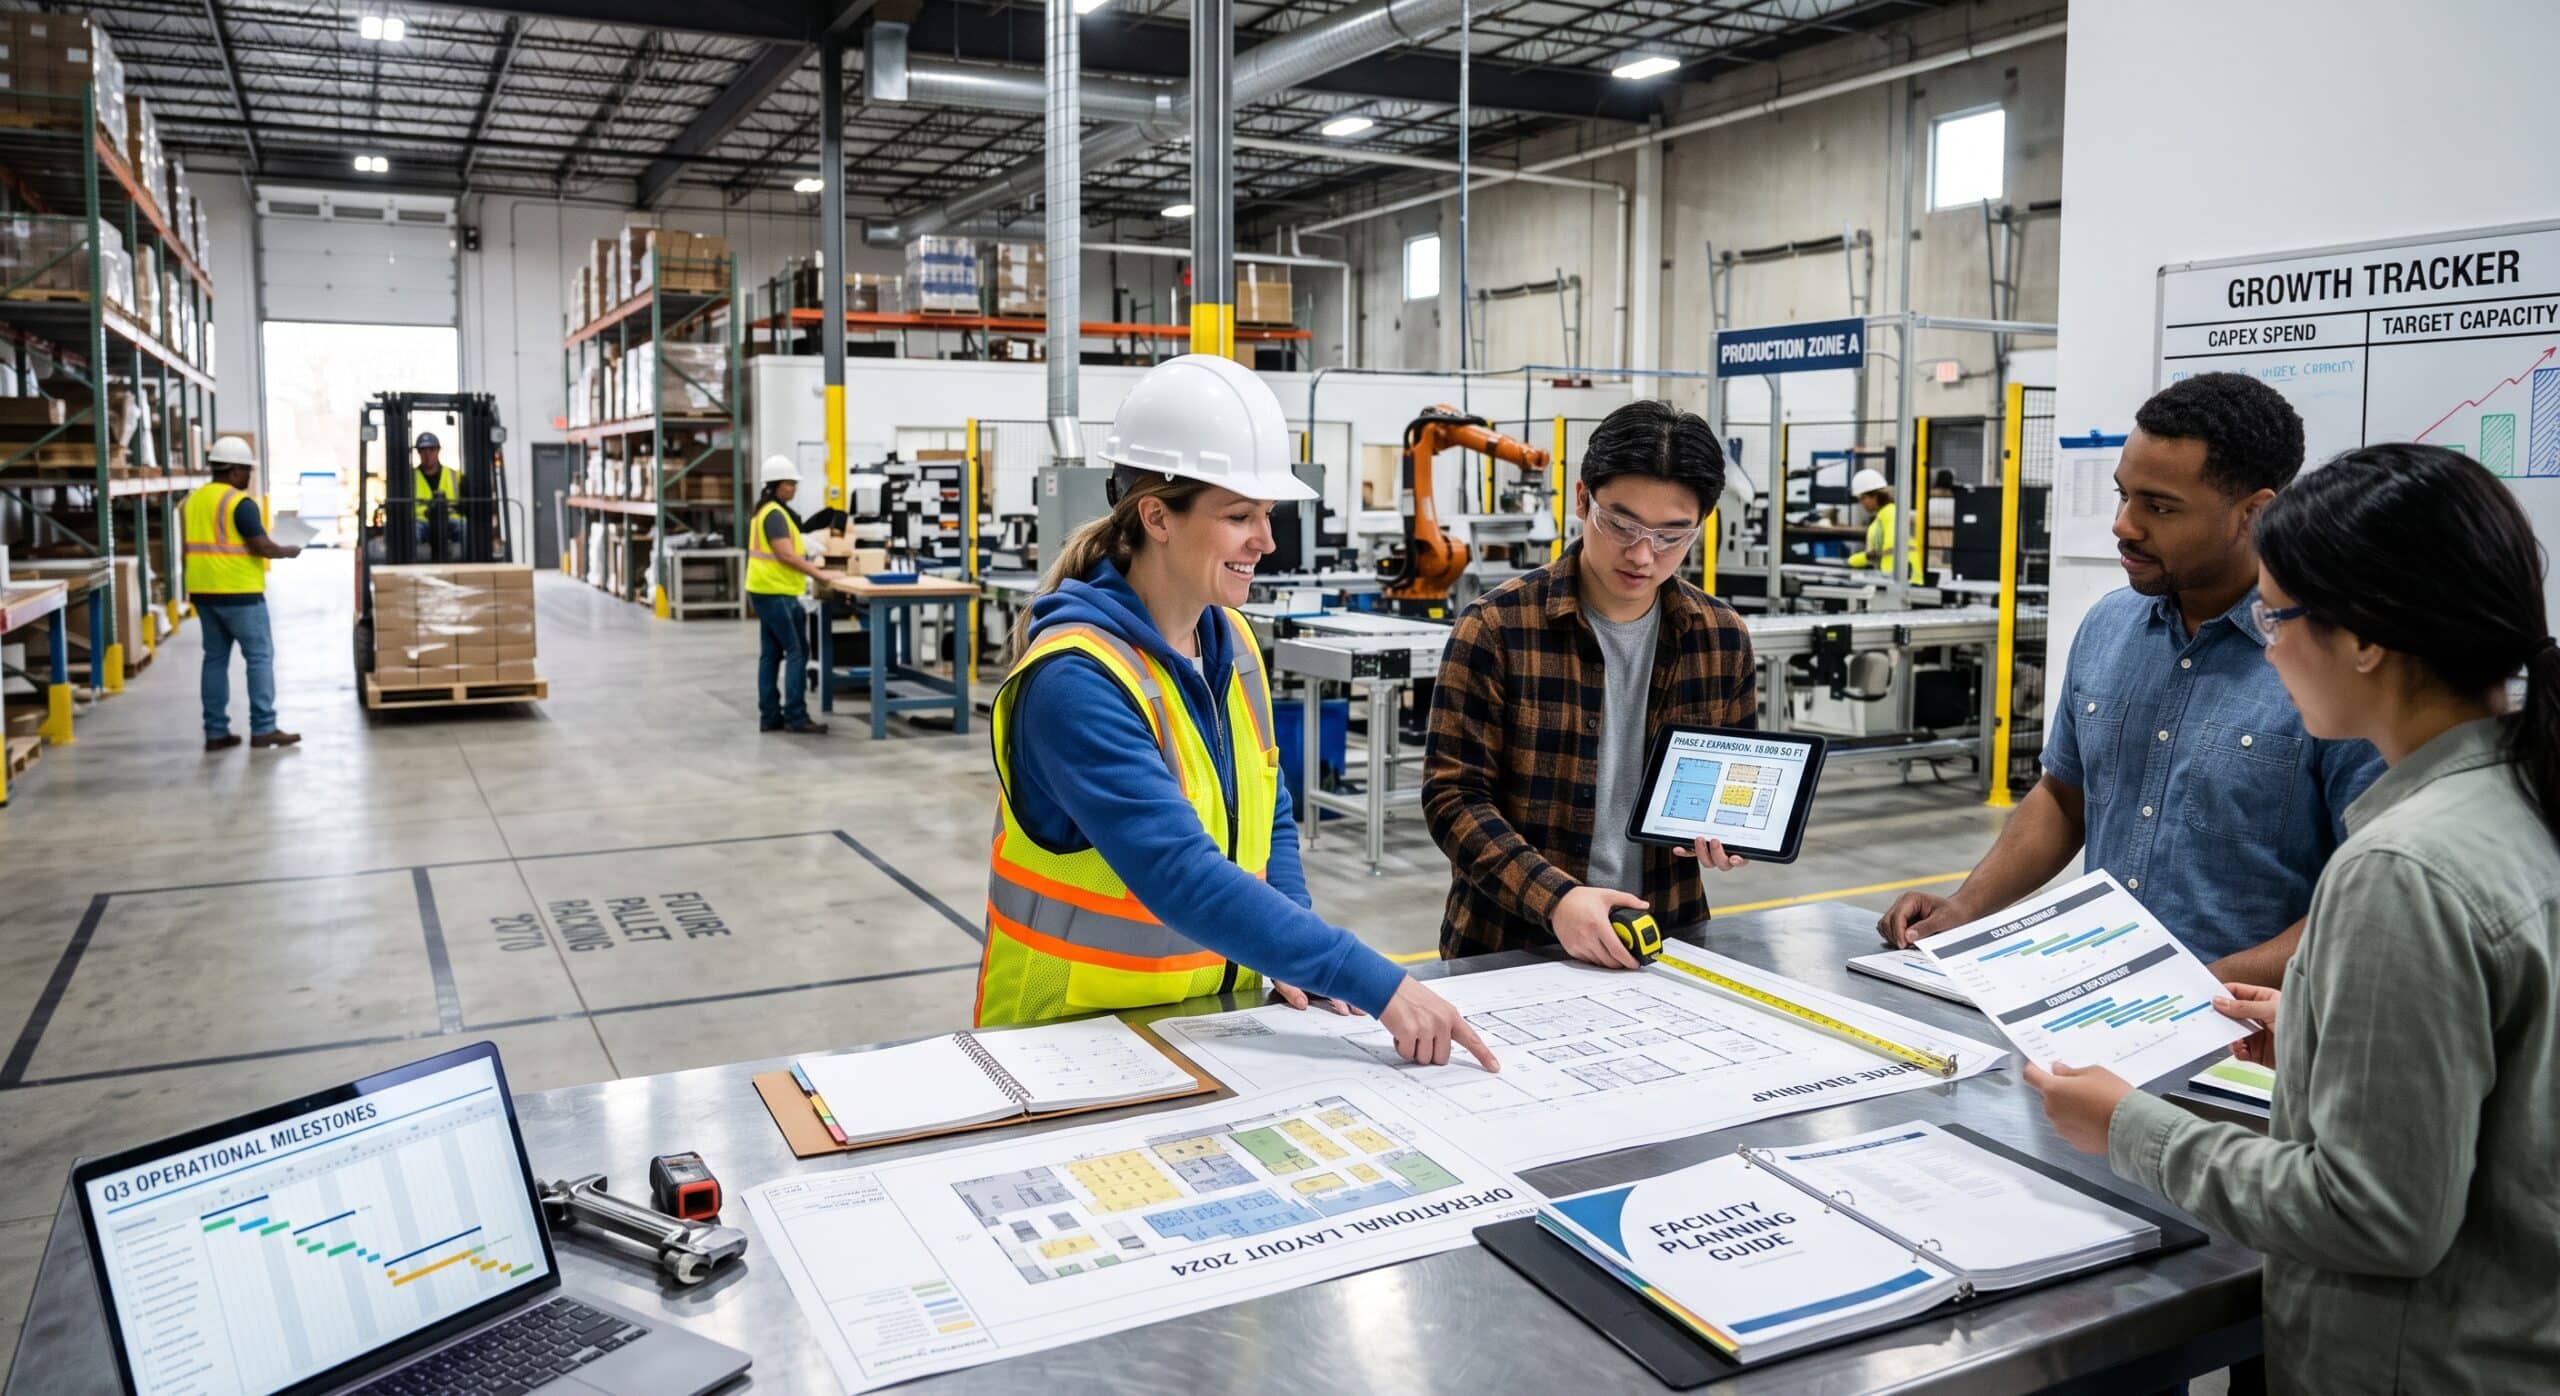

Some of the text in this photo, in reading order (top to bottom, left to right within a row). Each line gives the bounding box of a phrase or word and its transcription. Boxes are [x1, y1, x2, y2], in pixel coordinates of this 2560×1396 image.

[2227, 249, 2520, 309] GROWTH TRACKER
[2208, 323, 2317, 347] CAPEX SPEND
[2382, 303, 2558, 336] TARGET CAPACITY
[1721, 332, 1859, 364] PRODUCTION ZONE A
[1674, 737, 1700, 747] PHASE
[547, 899, 615, 952] RACKING
[604, 896, 673, 942] PALLET
[658, 891, 732, 940] FUTURE
[104, 1102, 378, 1203] Q3 OPERATIONAL MILESTONES
[1344, 1187, 1514, 1236] OPERATIONAL
[1649, 1200, 1761, 1238] FACILITY
[1245, 1228, 1344, 1262] LAYOUT
[1657, 1211, 1797, 1254] PLANNING
[1708, 1232, 1793, 1262] GUIDE
[1170, 1252, 1238, 1277] 2024
